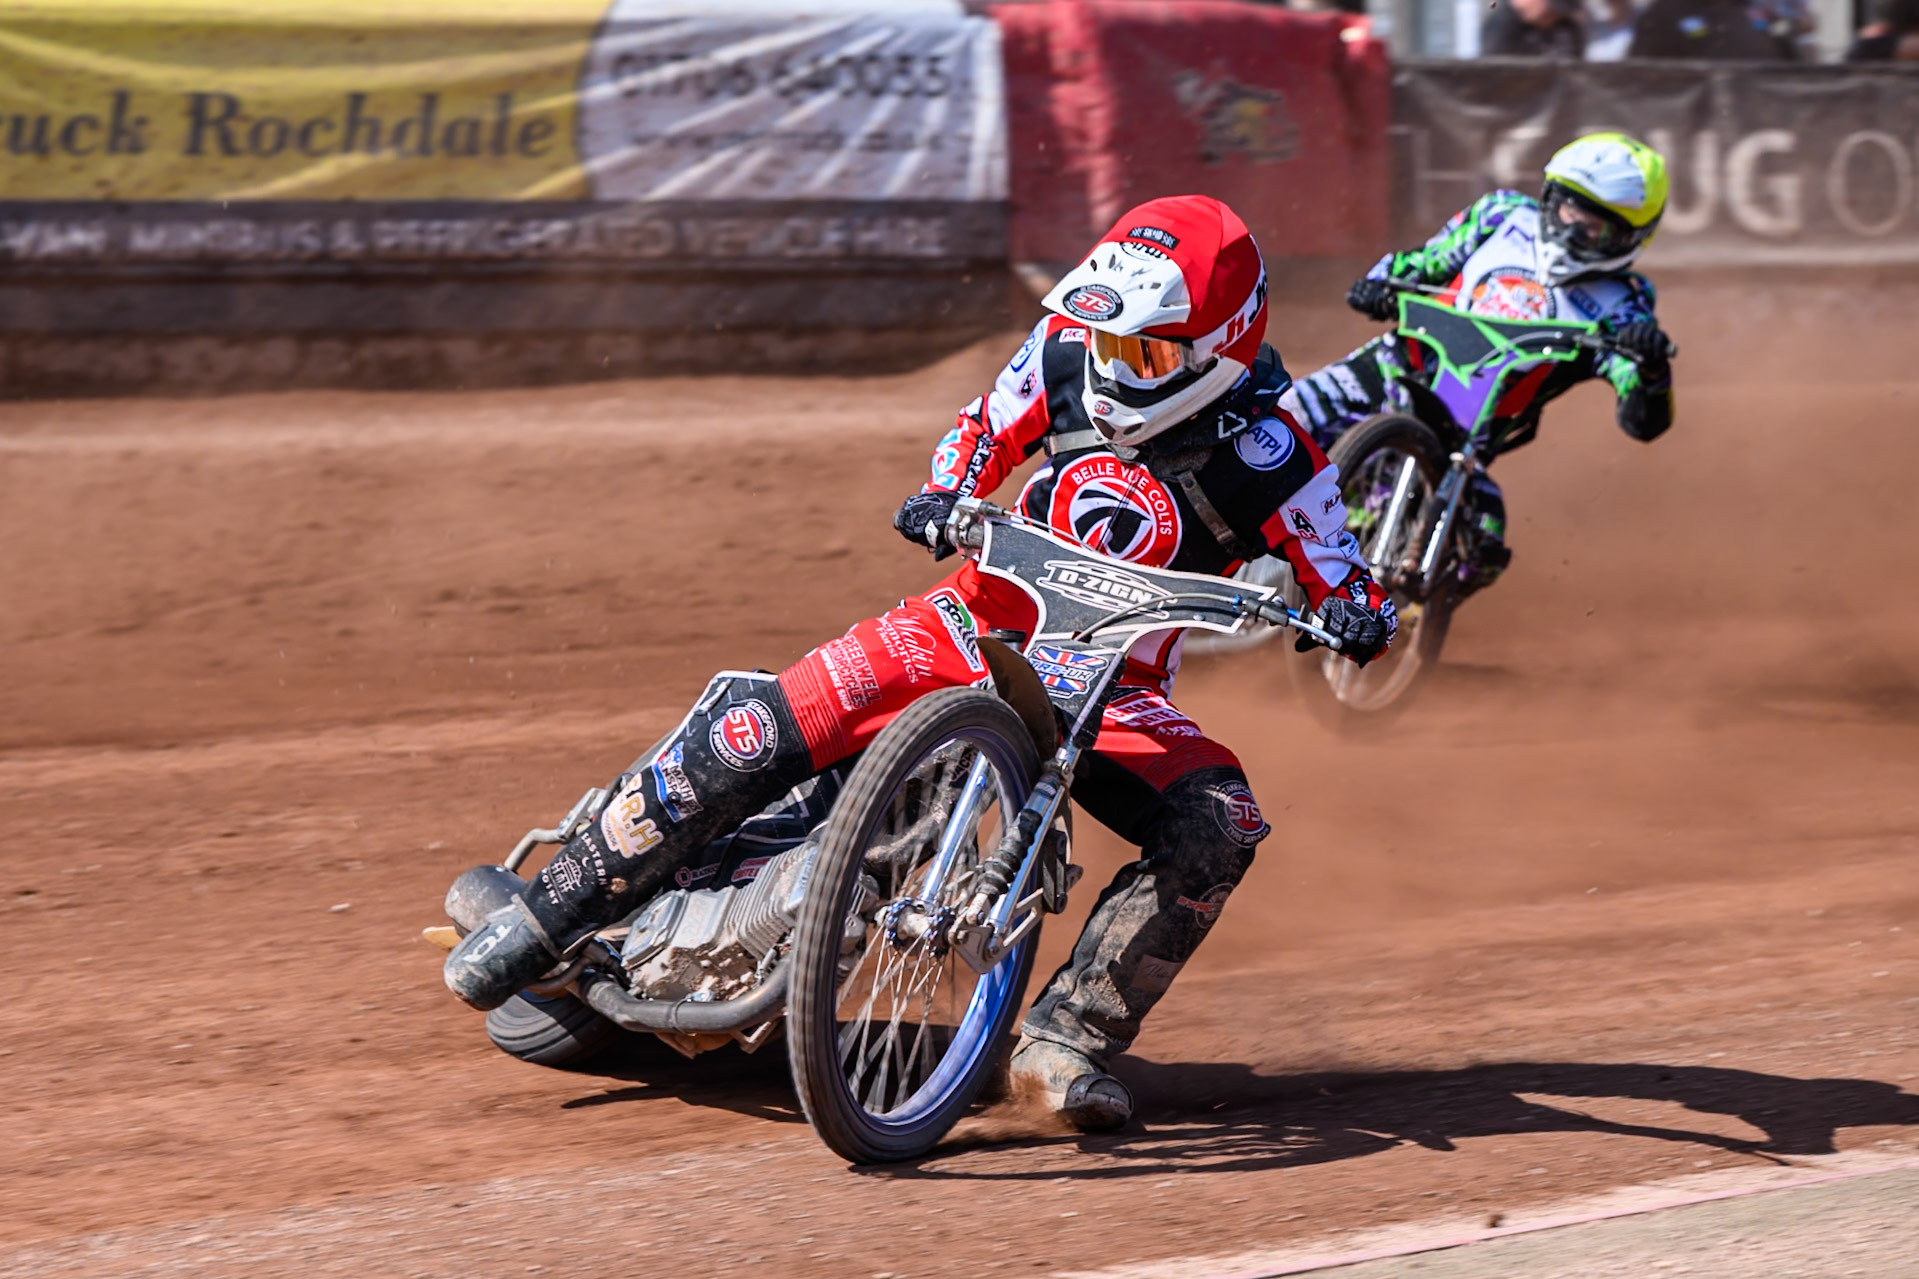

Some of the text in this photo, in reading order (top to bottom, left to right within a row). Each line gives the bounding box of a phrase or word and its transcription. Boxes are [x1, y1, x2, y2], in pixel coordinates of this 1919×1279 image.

[182, 92, 556, 158] Rochdale
[1072, 291, 1112, 312] STS
[1094, 400, 1112, 414] STS
[1247, 426, 1282, 456] ATPI
[1071, 462, 1173, 536] BELLE VUE COLTS
[1057, 569, 1153, 605] D-ZIGN
[875, 625, 899, 659] Florist
[836, 687, 853, 712] SHOP
[726, 709, 761, 753] STS
[744, 701, 775, 749] STAKEFORD
[1228, 801, 1261, 822] STS
